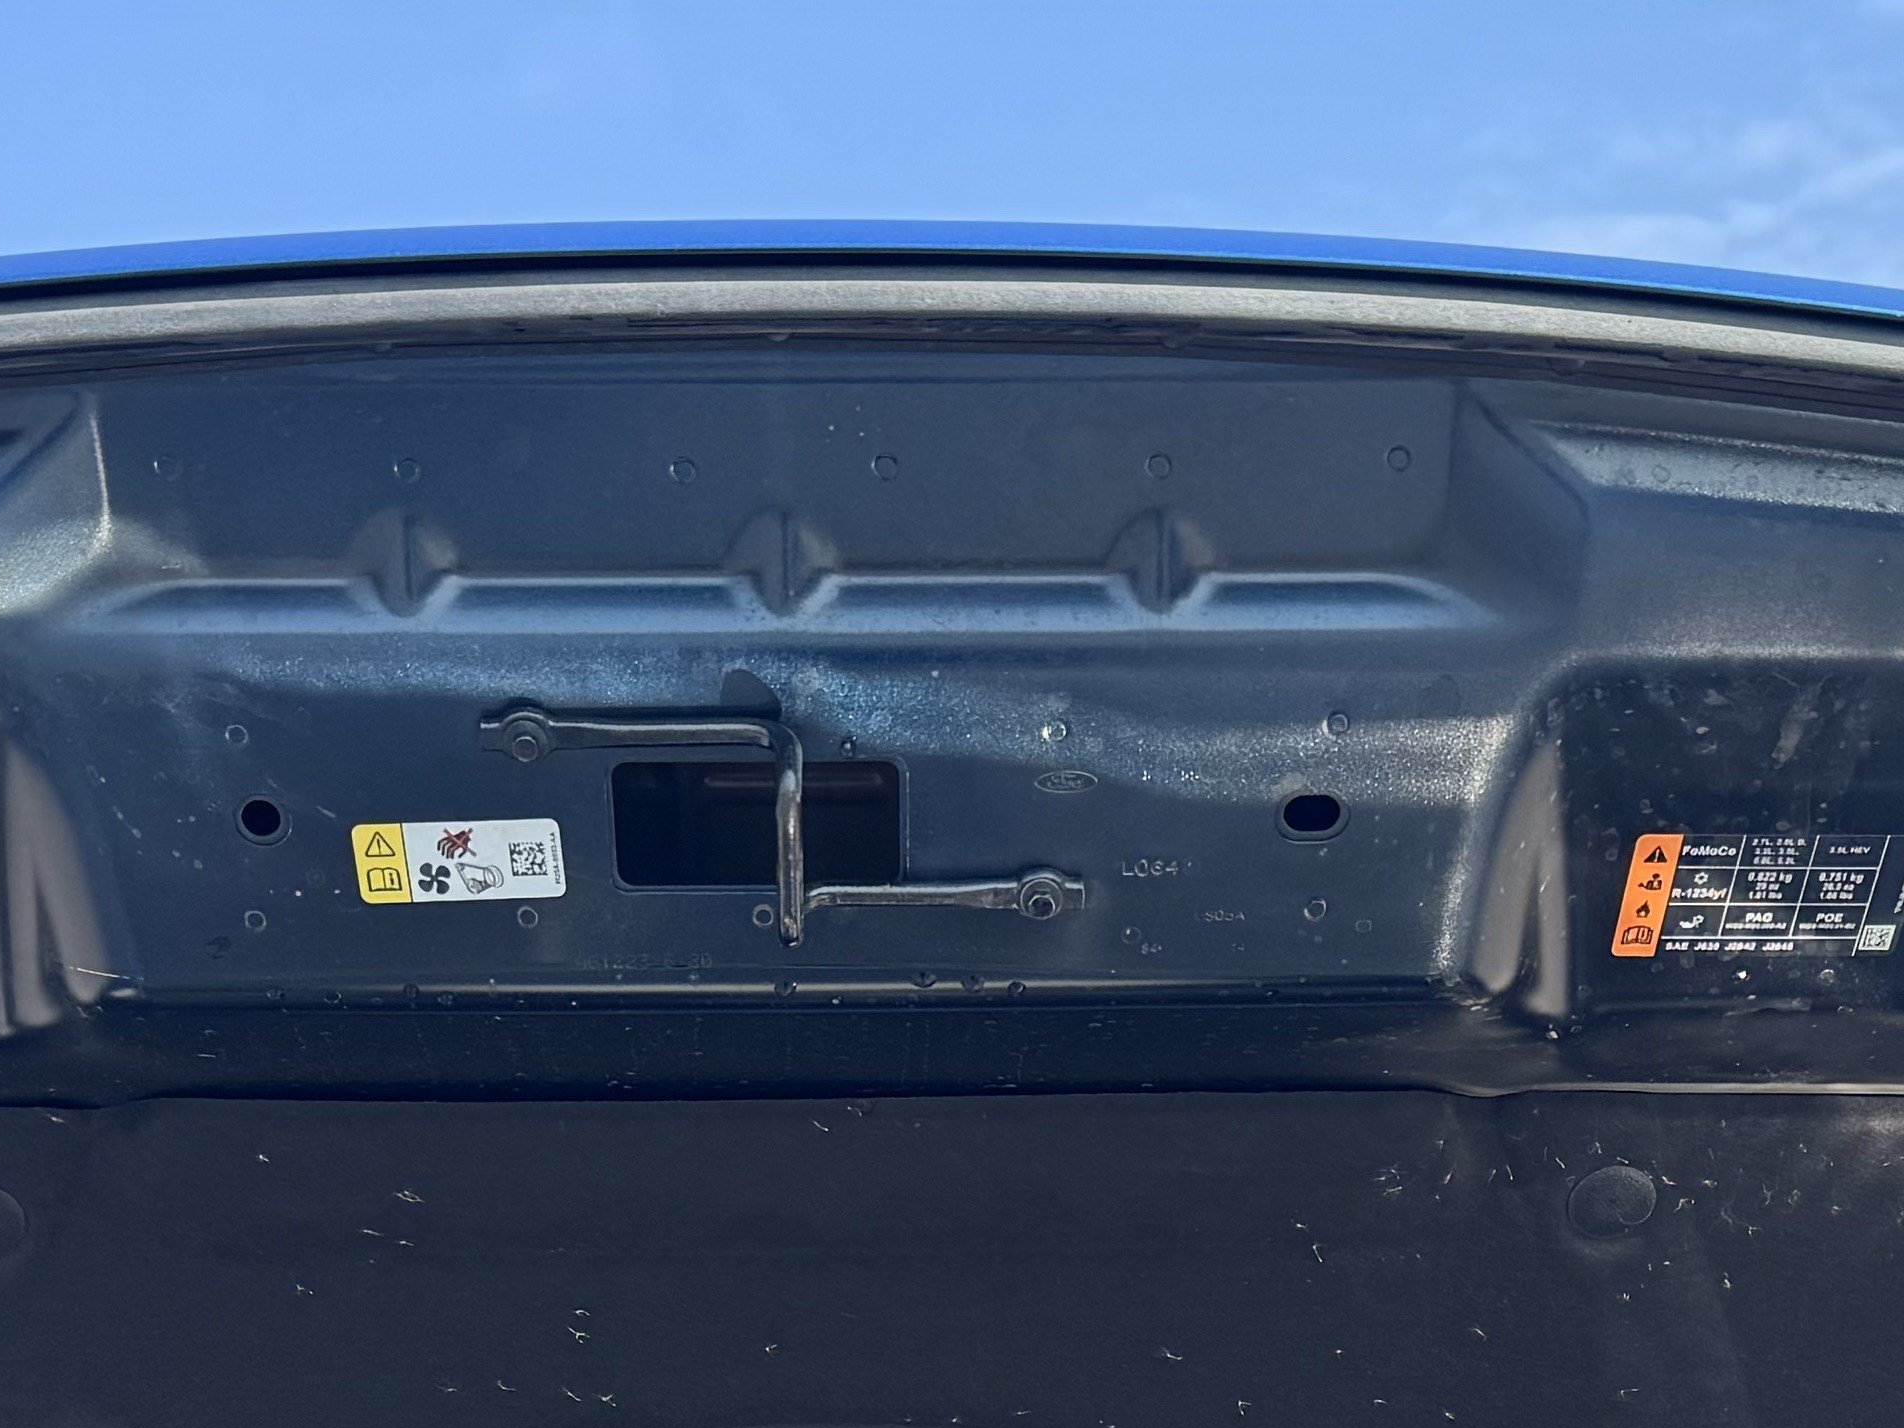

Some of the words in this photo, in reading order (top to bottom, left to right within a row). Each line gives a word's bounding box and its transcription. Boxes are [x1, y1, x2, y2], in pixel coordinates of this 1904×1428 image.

[1682, 845, 1737, 857] FoMoCo
[1779, 872, 1793, 884] kg
[1850, 872, 1865, 884] kg
[1671, 887, 1727, 901] R-1234yf
[1746, 912, 1773, 923] PAG
[1815, 912, 1844, 923] POE
[1665, 941, 1688, 951] SAE
